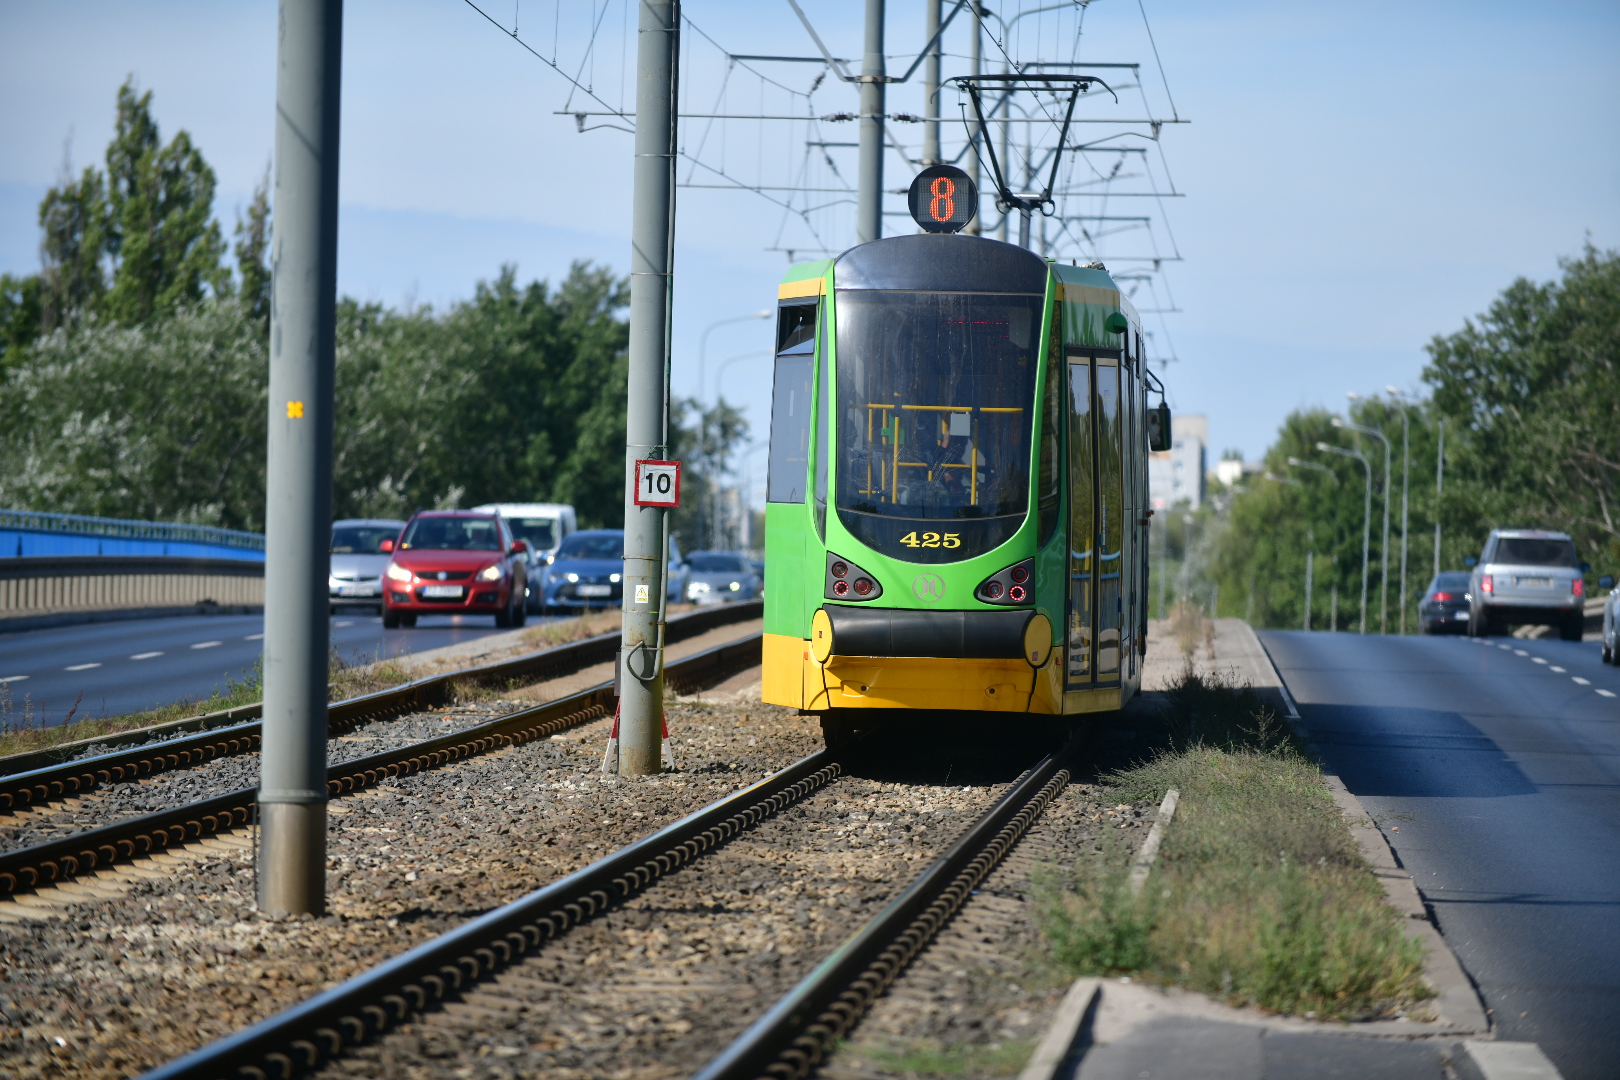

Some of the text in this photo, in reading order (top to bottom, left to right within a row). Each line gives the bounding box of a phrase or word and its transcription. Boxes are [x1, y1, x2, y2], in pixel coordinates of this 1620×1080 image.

[930, 177, 955, 222] 8
[645, 473, 671, 494] 10
[899, 531, 961, 549] 425
